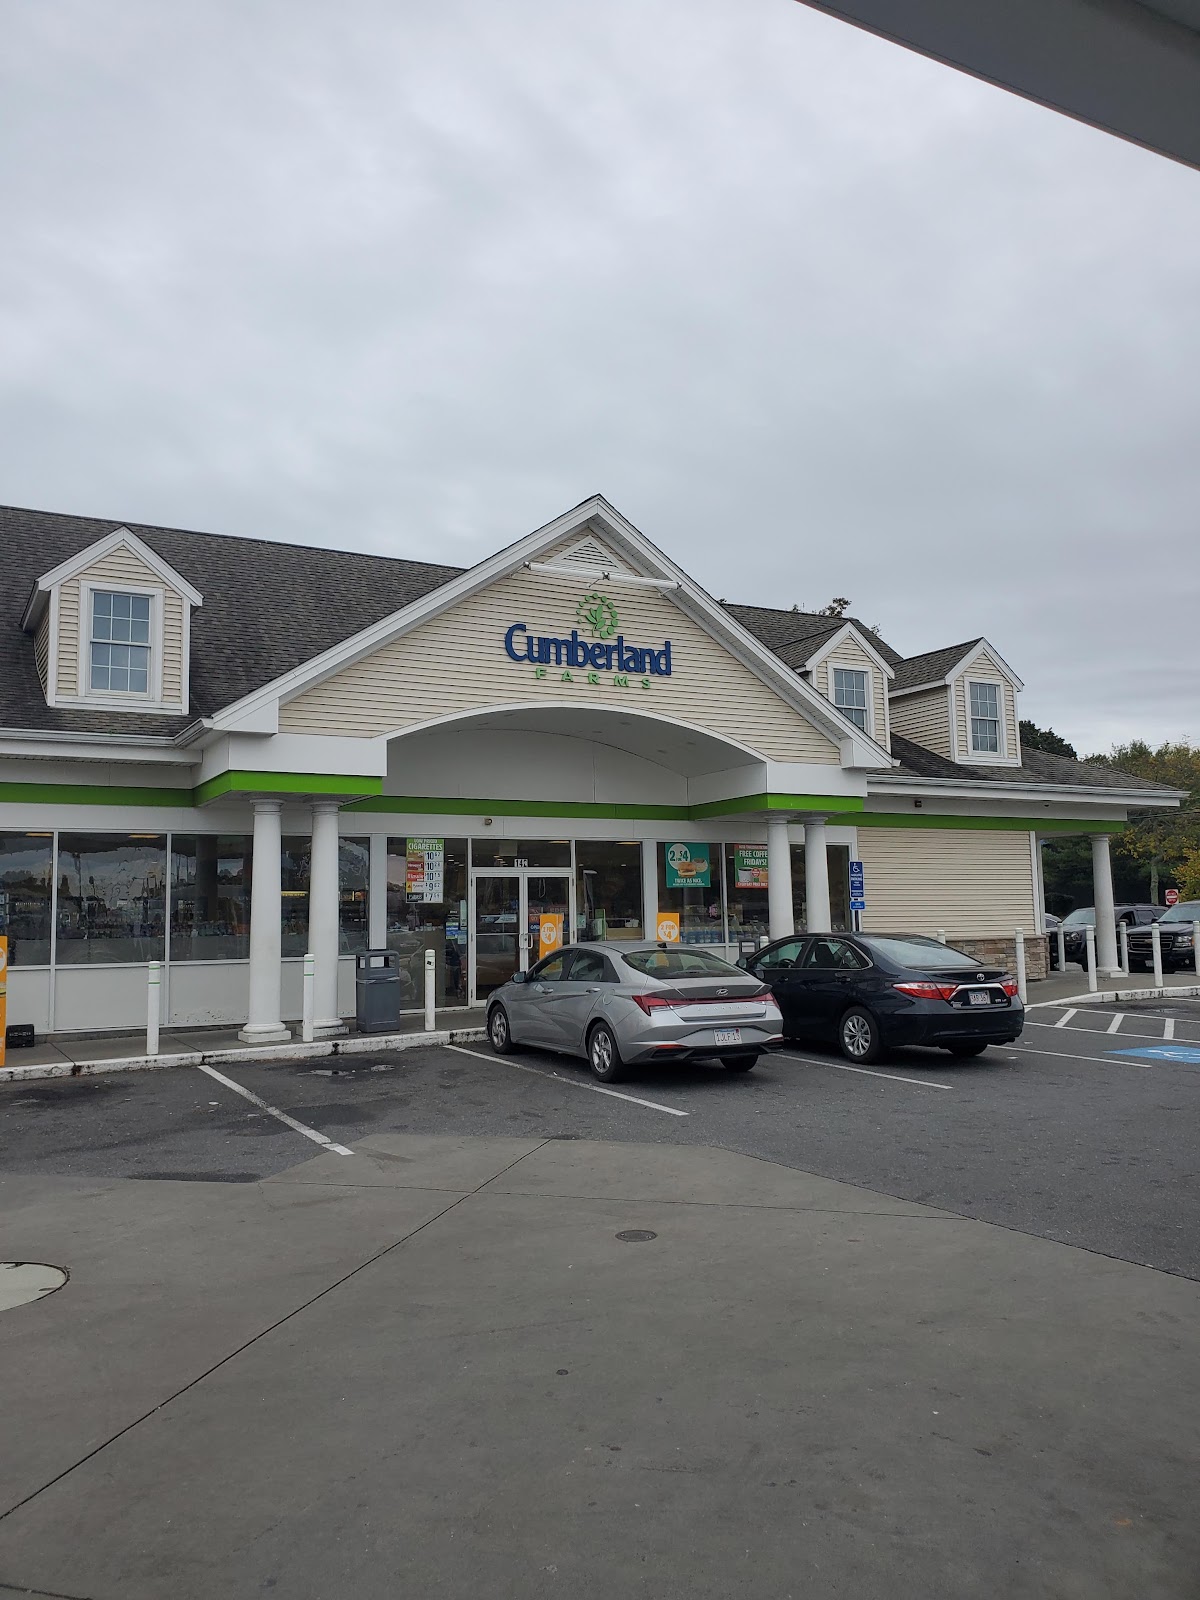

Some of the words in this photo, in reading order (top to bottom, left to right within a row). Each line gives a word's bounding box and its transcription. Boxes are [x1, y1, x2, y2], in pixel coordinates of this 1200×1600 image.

[504, 623, 672, 676] Cumberland
[535, 666, 652, 690] FARMS
[408, 843, 443, 851] CIGARETTES
[739, 850, 752, 858] FREE
[743, 858, 767, 866] FRIDAYS!
[663, 931, 672, 940] $4
